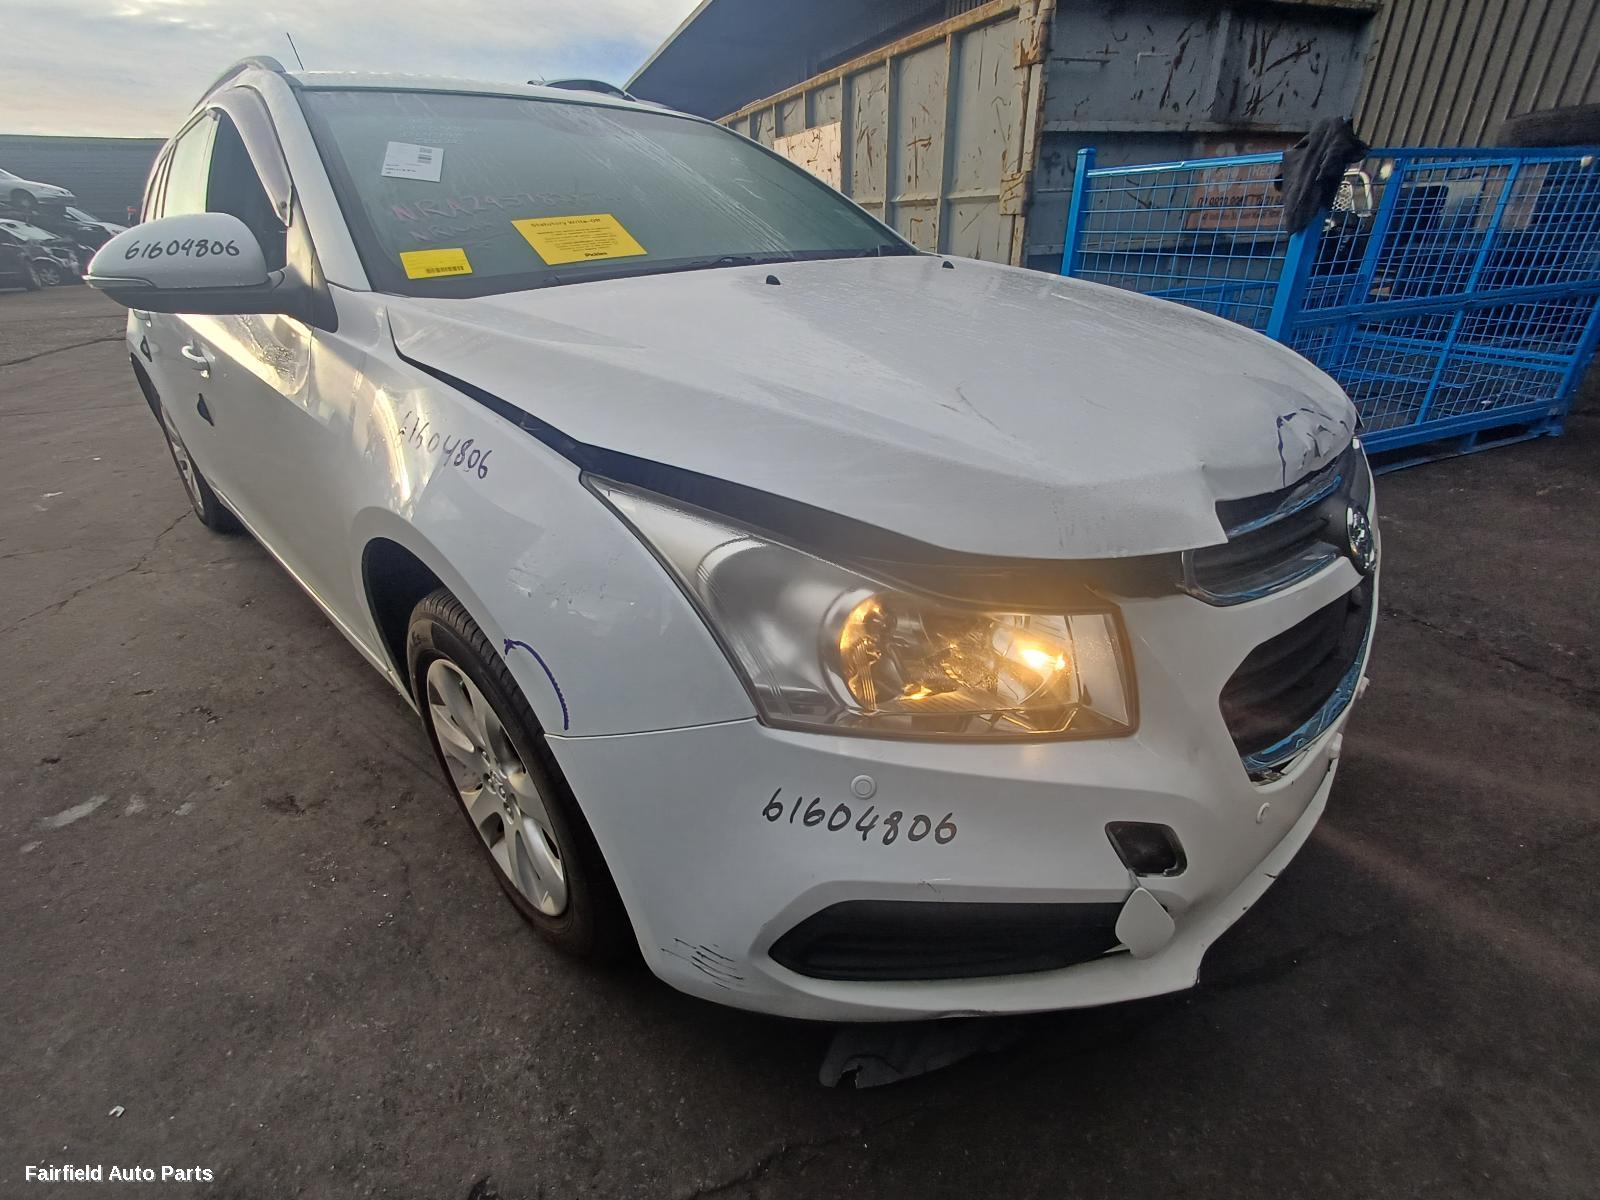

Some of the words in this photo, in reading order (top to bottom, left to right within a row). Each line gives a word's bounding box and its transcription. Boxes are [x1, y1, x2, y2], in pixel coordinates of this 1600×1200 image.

[567, 217, 601, 225] Write-Off
[124, 238, 240, 261] 61604806
[762, 787, 957, 846] 61604806
